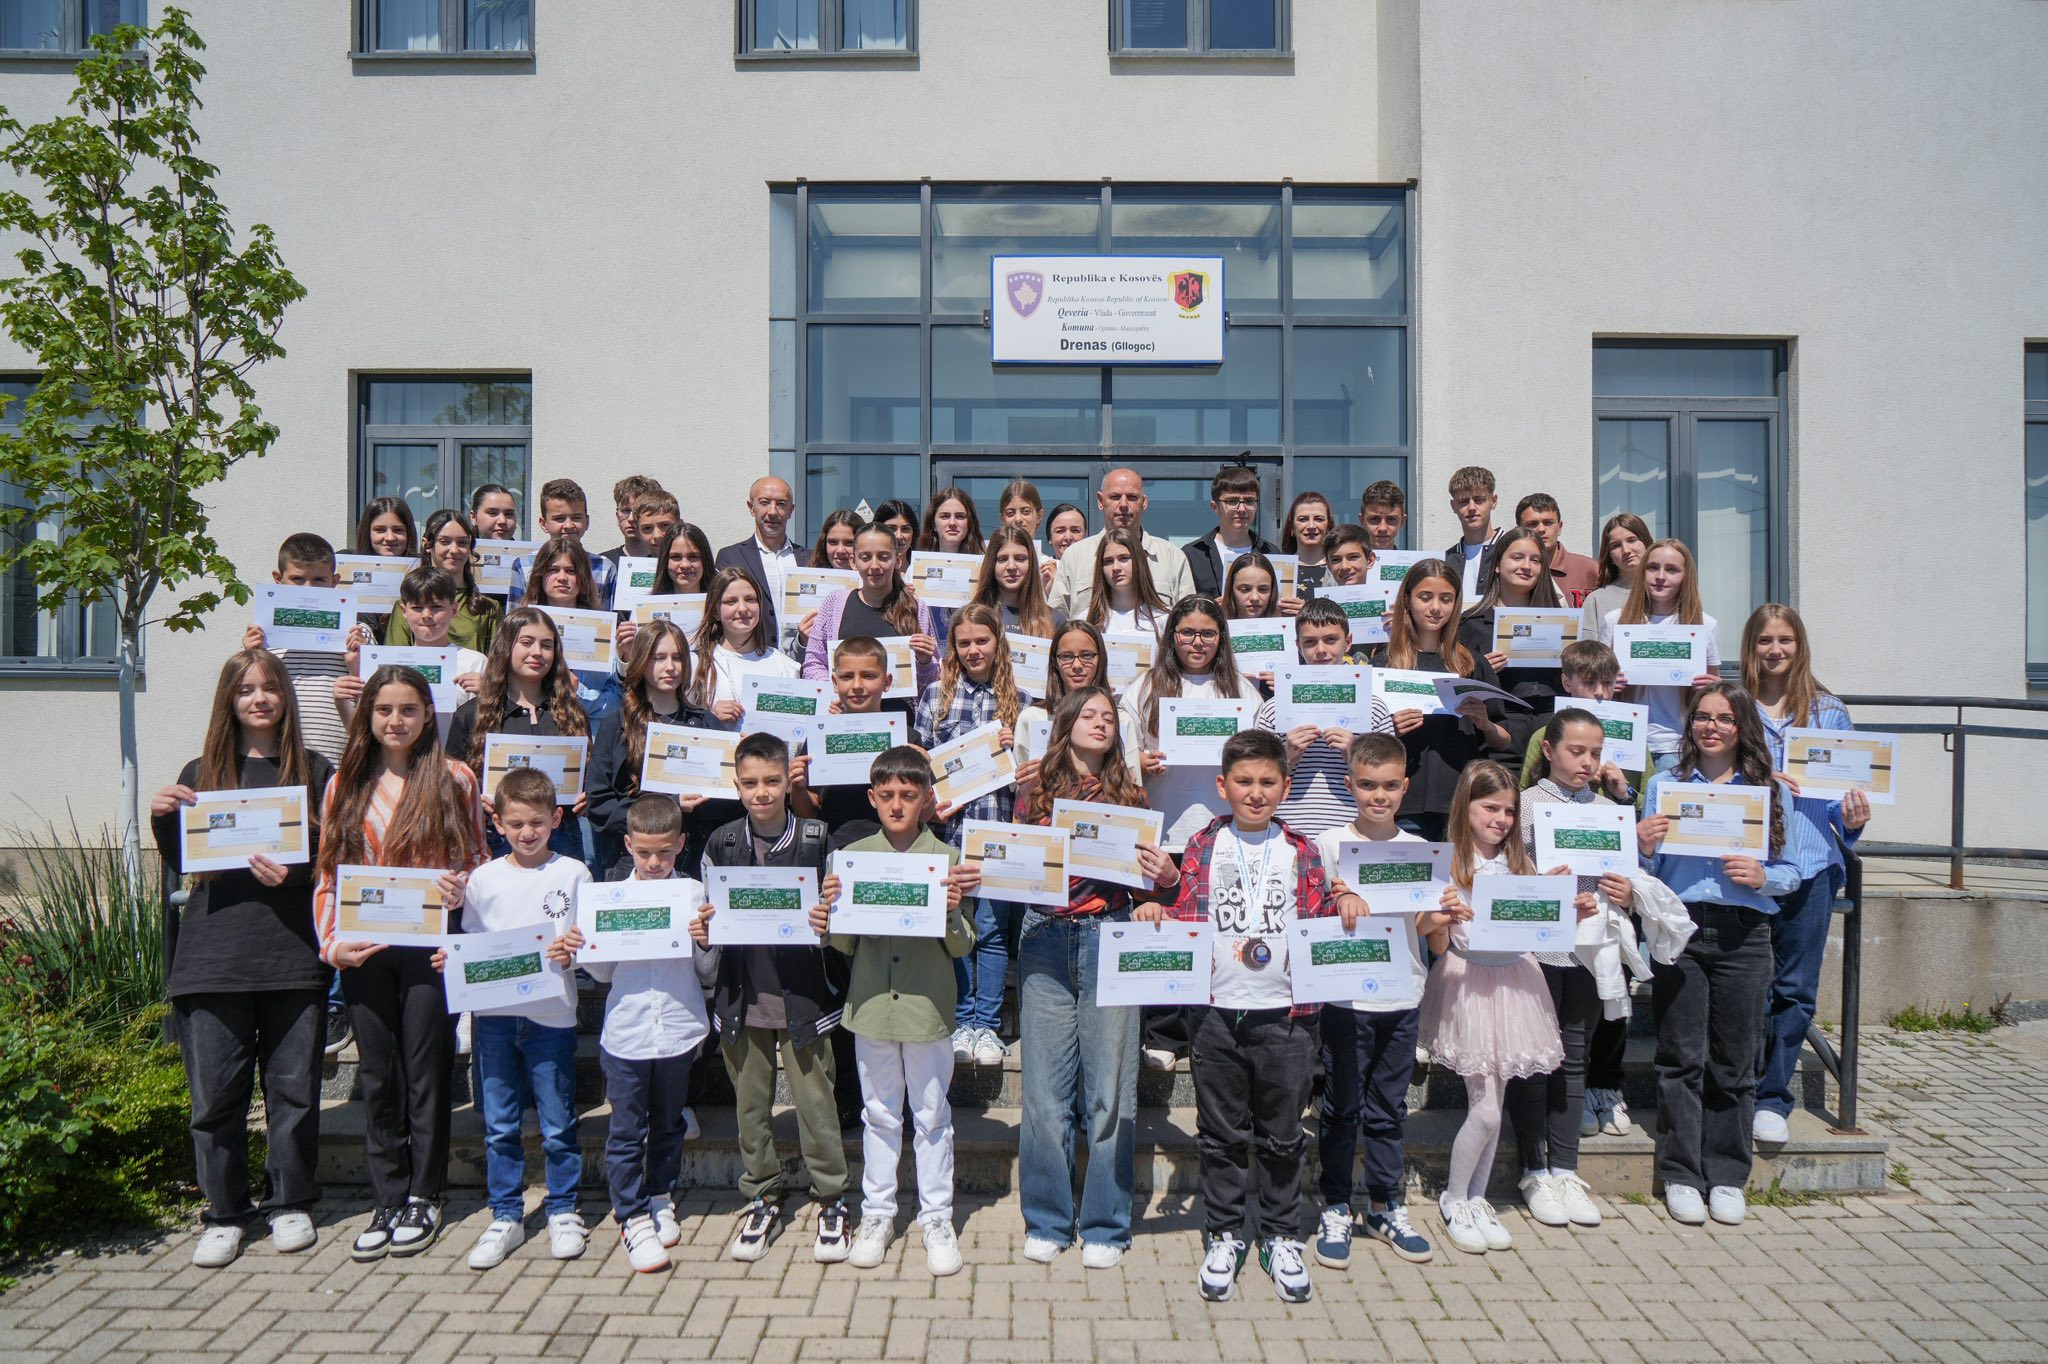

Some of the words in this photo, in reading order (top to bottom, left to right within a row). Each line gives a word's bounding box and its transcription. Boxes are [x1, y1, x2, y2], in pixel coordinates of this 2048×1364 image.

[1052, 274, 1107, 285] Republika
[1120, 273, 1162, 283] Kosovës
[1048, 296, 1079, 304] Republika
[1057, 307, 1089, 318] Qeveria
[1094, 309, 1113, 317] Vlada
[1118, 309, 1157, 317] Government
[1061, 322, 1094, 332] Komuna
[1060, 338, 1107, 351] Drenas
[1111, 341, 1155, 353] (Gllogoc)
[543, 889, 571, 919] ENGINEERED
